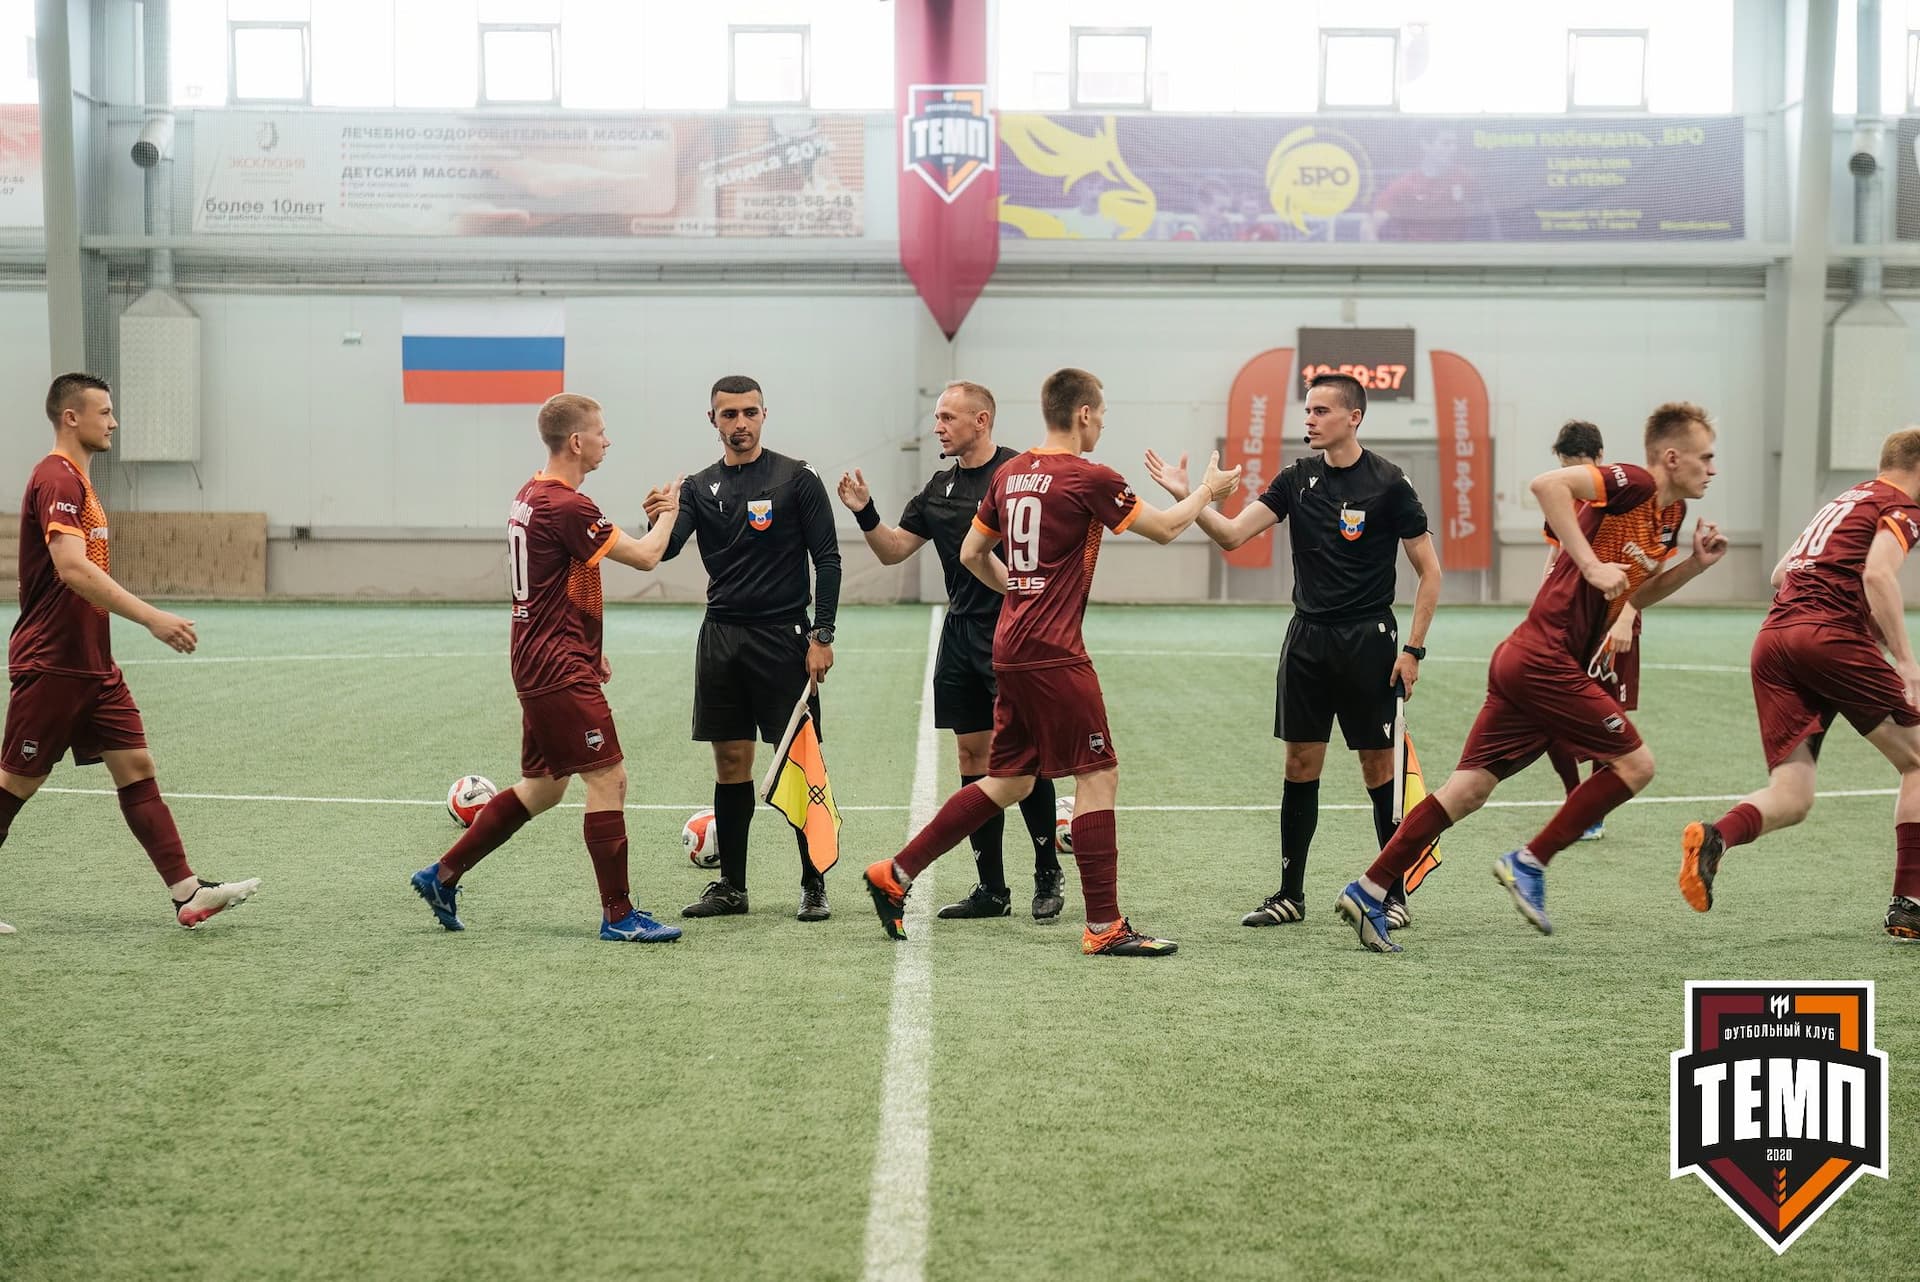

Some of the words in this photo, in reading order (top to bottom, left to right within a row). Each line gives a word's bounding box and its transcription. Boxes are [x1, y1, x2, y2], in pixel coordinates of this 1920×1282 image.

[912, 118, 986, 158] ТЕМП
[341, 164, 417, 180] ДЕТСКИЙ
[205, 199, 265, 214] более
[1243, 394, 1268, 455] Банк
[1006, 474, 1053, 495] ШИБАЕВ
[1006, 496, 1042, 572] 19
